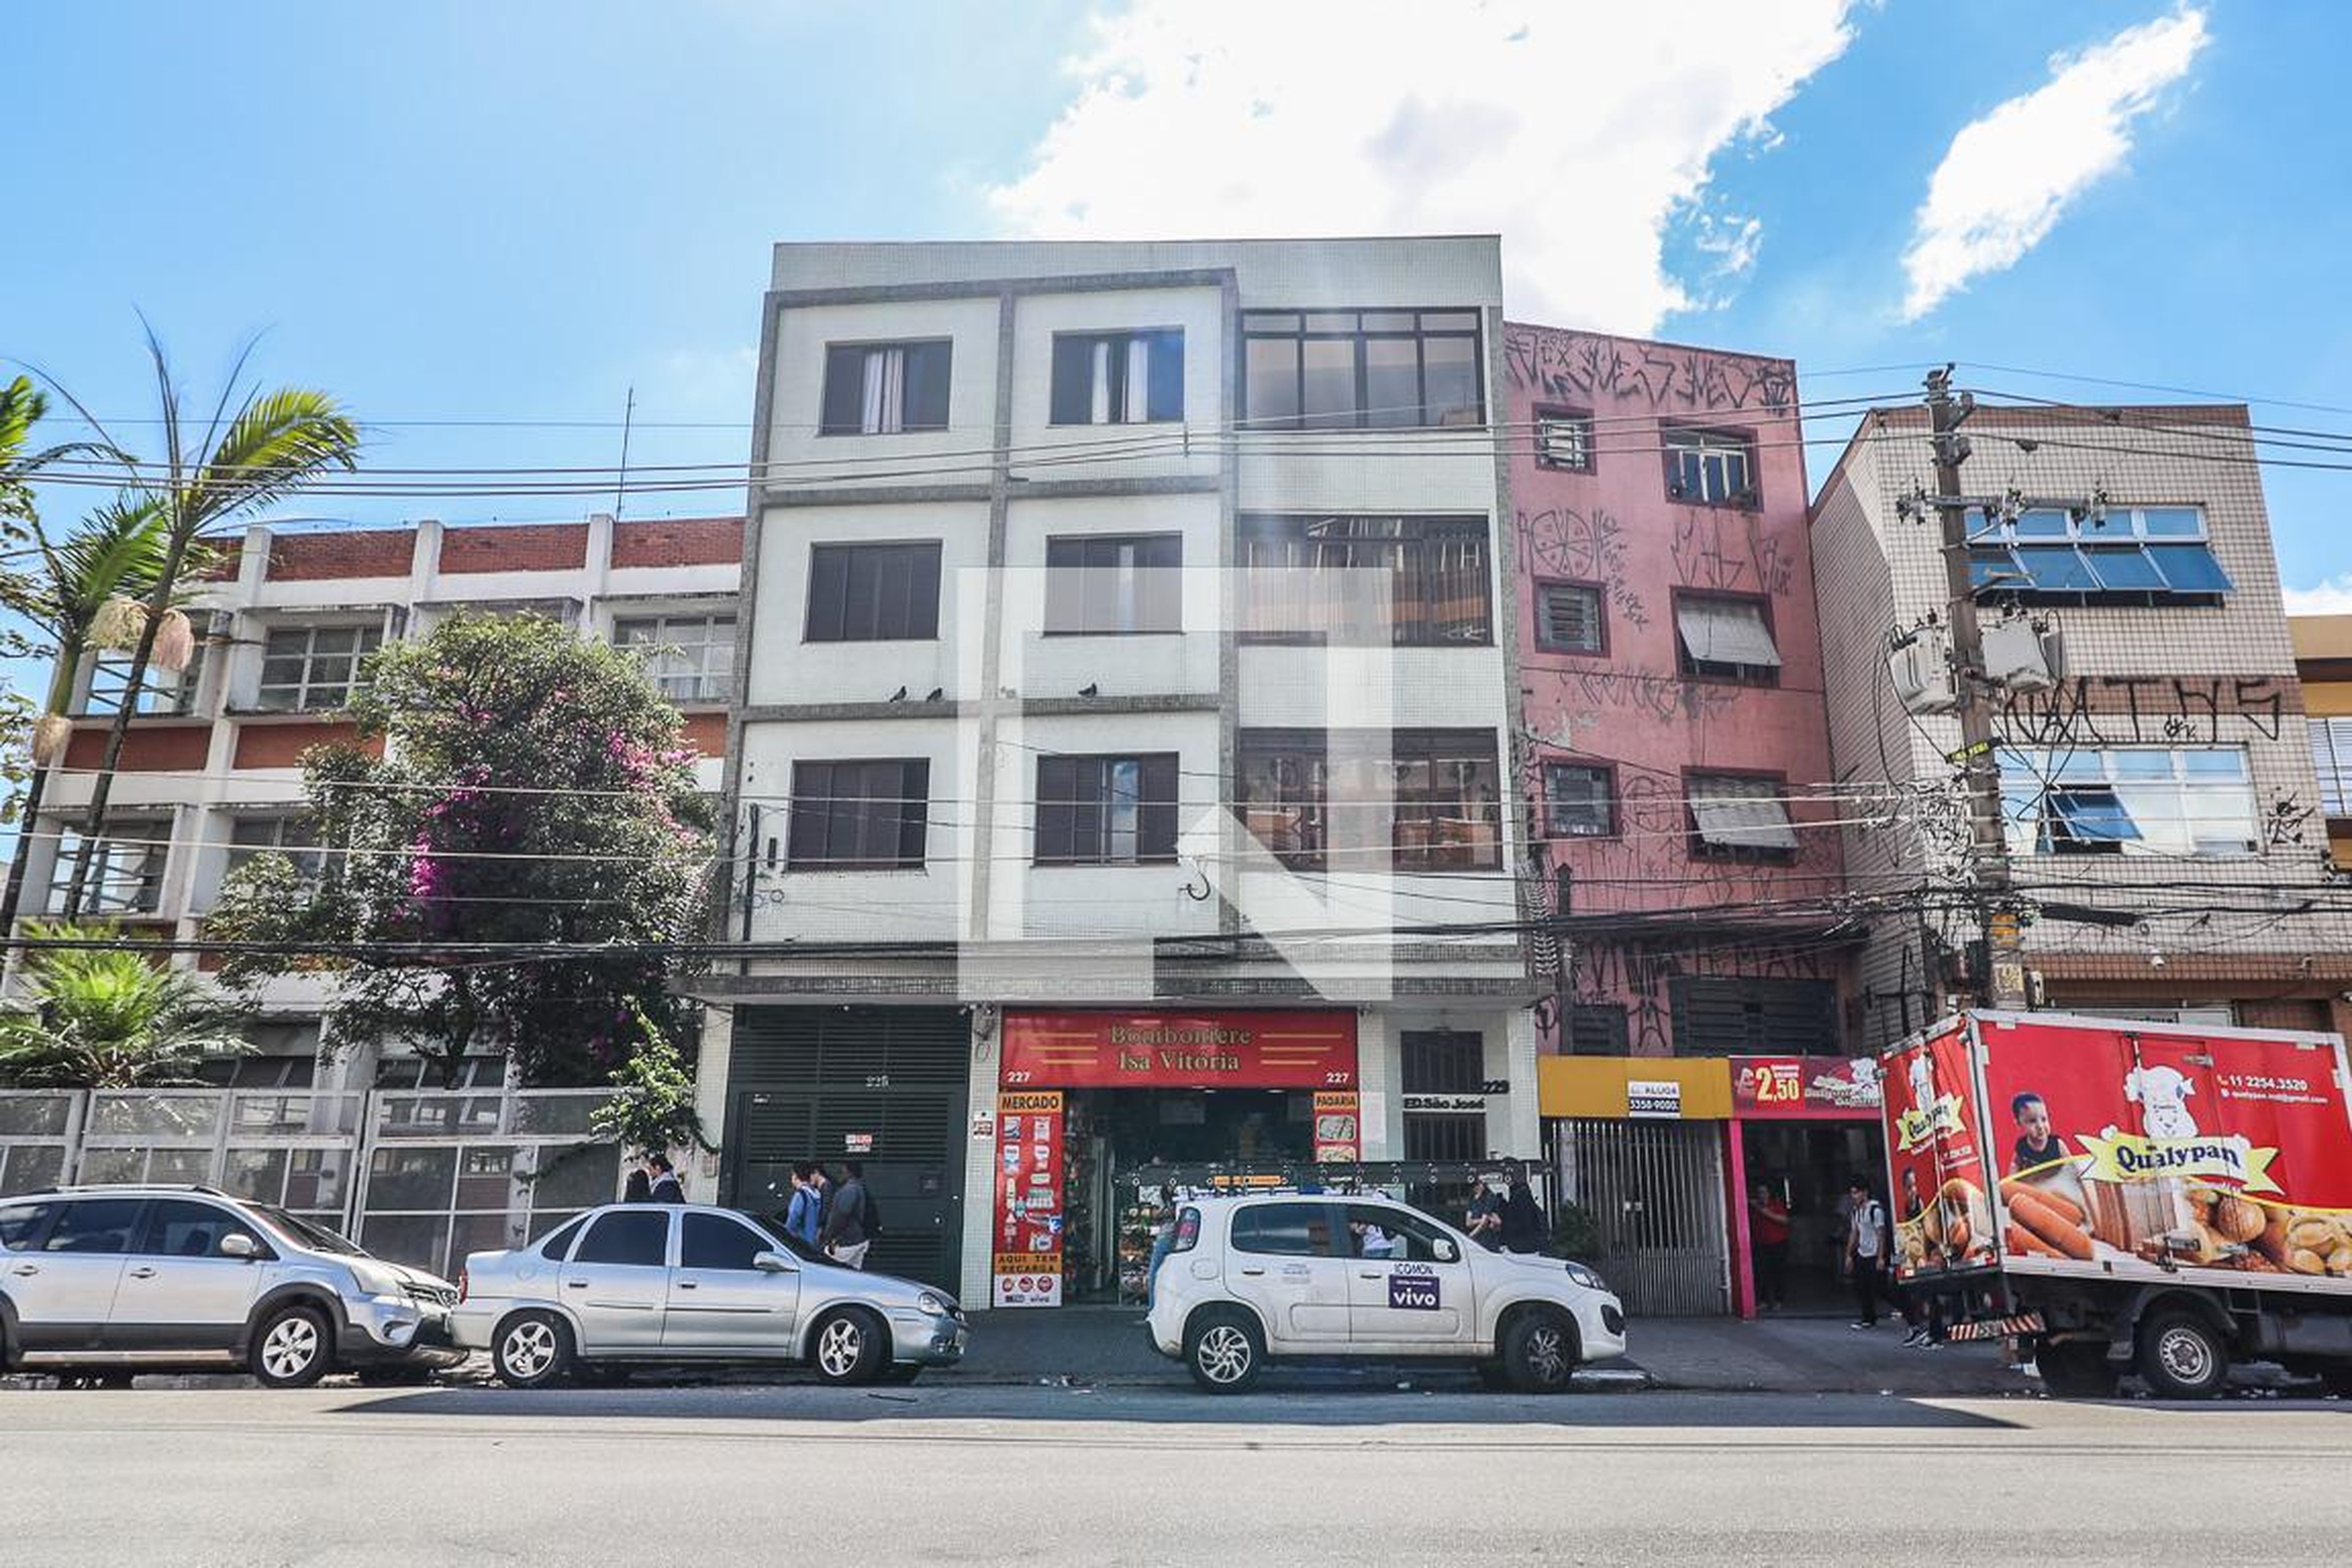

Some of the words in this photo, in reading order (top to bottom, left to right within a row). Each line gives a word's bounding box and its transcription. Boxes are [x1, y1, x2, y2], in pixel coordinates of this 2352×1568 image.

[1110, 1027, 1251, 1044] Bomboniere
[1120, 1052, 1150, 1070] Isa
[1008, 1071, 1031, 1083] 227
[1325, 1072, 1349, 1084] 227
[1756, 1067, 1800, 1102] 2,50
[2229, 1075, 2243, 1086] 11
[1002, 1095, 1059, 1109] MERCADO
[2116, 1144, 2241, 1173] Qualypan
[1393, 1287, 1436, 1306] vivo
